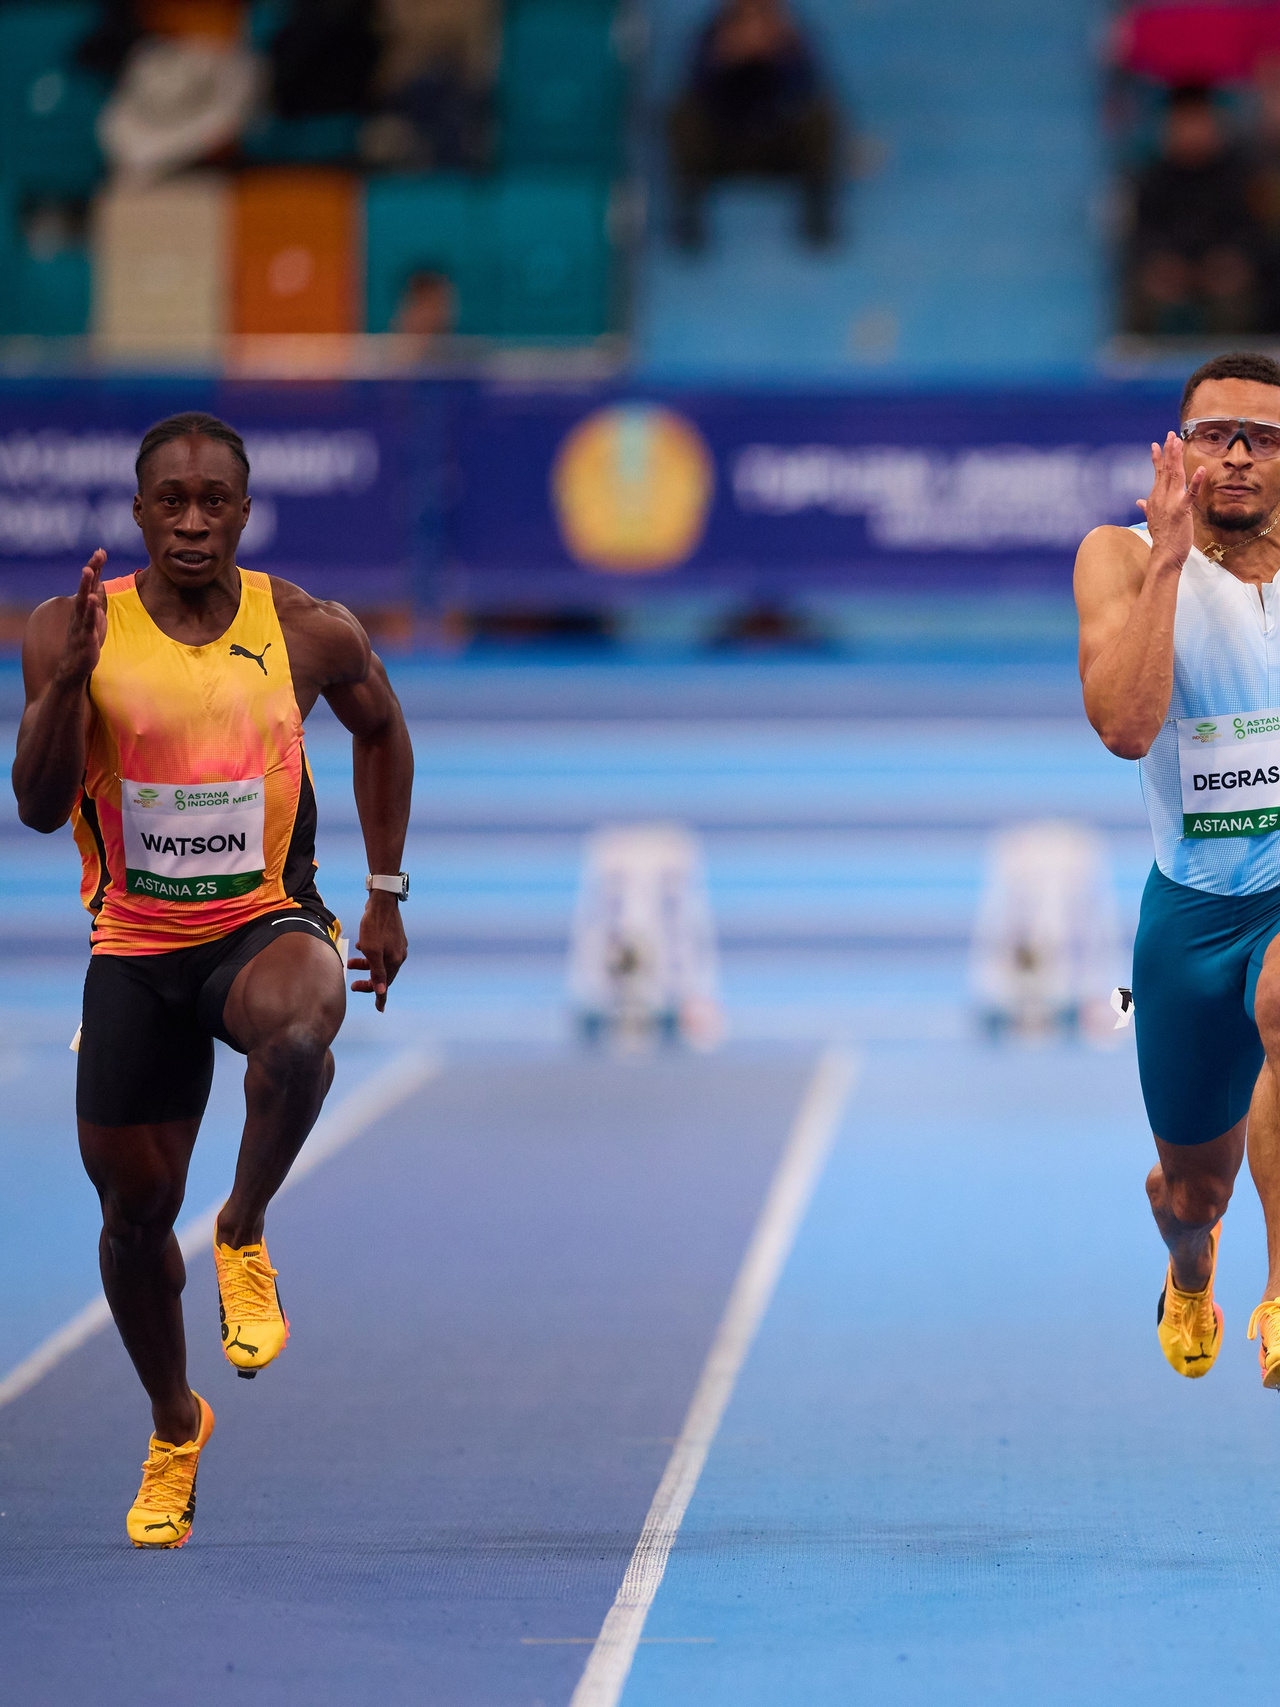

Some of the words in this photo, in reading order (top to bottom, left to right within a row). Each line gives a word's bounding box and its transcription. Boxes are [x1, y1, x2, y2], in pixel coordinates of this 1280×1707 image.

[188, 799, 229, 807] INDOOR
[232, 792, 259, 805] MEET
[1192, 818, 1254, 832] ASTANA
[1258, 814, 1278, 829] 25
[140, 832, 246, 857] WATSON
[135, 877, 192, 896] ASTANA
[195, 881, 218, 896] 25
